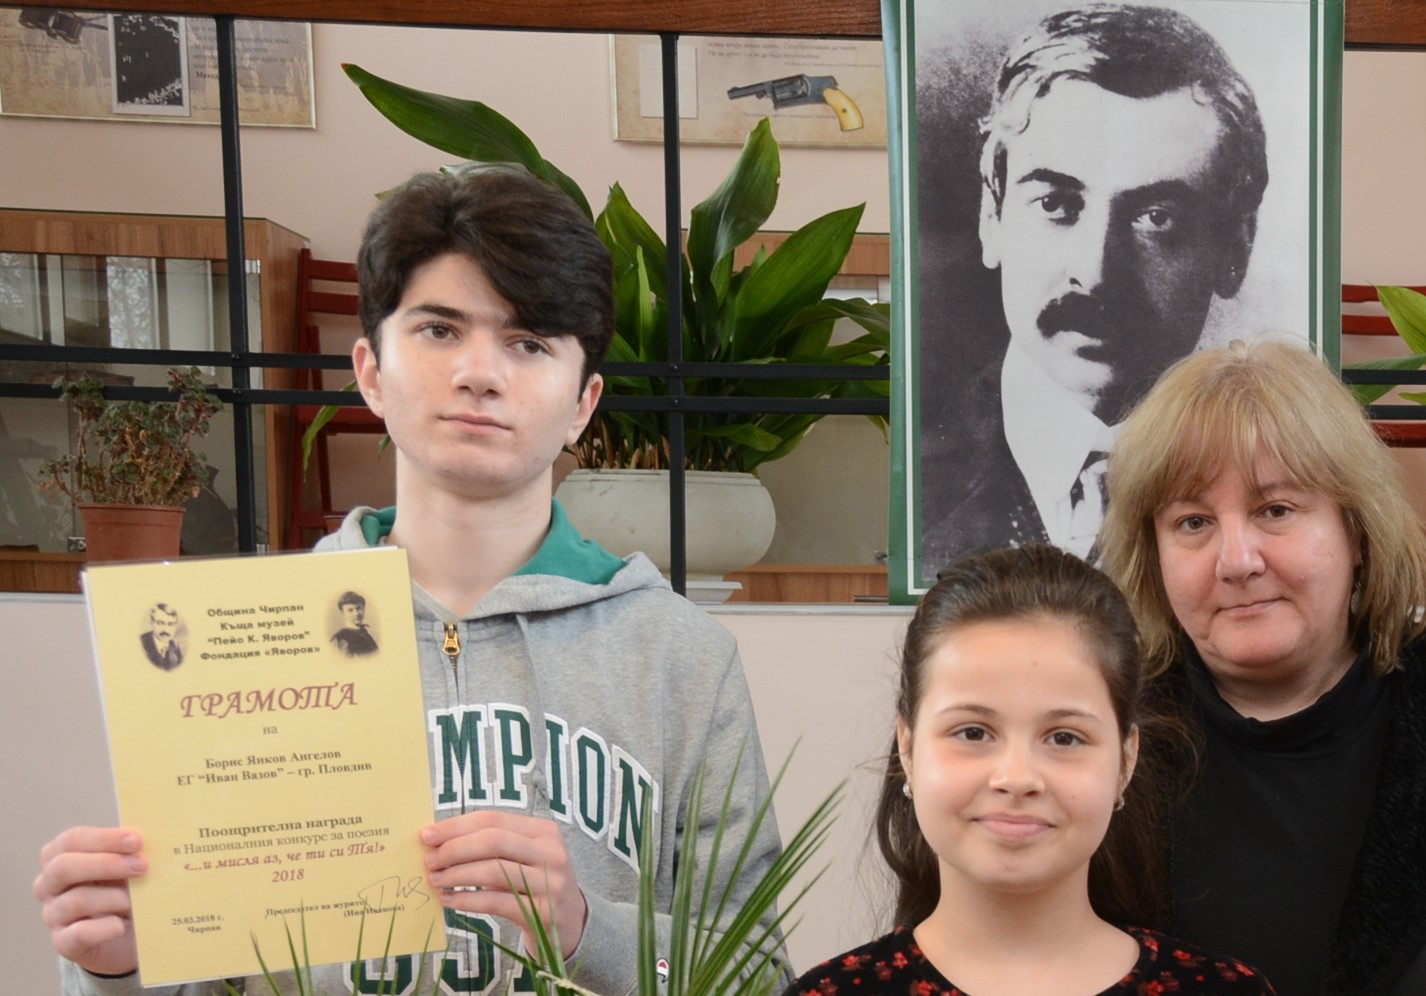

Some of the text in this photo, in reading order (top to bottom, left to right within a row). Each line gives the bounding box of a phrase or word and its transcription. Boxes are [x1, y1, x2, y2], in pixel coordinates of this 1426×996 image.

[207, 604, 304, 617] Община Чирпан
[220, 617, 294, 631] Къща музей
[248, 635, 259, 643] К.
[200, 649, 260, 660] Фондация
[180, 682, 358, 719] ГРАМОТА
[263, 725, 278, 735] на
[205, 750, 342, 771] Борис Янков Ангелов
[176, 774, 194, 786] ЕГ
[298, 768, 315, 778] гр.
[318, 762, 372, 775] Пловдив
[430, 704, 658, 878] MPION
[198, 816, 363, 839] Поощрителна награда
[173, 827, 390, 855] в Националния конкурс за поезия
[215, 856, 260, 869] мисля
[263, 853, 282, 865] аз,
[286, 852, 302, 862] че
[306, 850, 325, 860] ти
[329, 848, 344, 858] си
[272, 869, 305, 883] 2018
[321, 903, 332, 911] на
[188, 924, 221, 935] Чирпан
